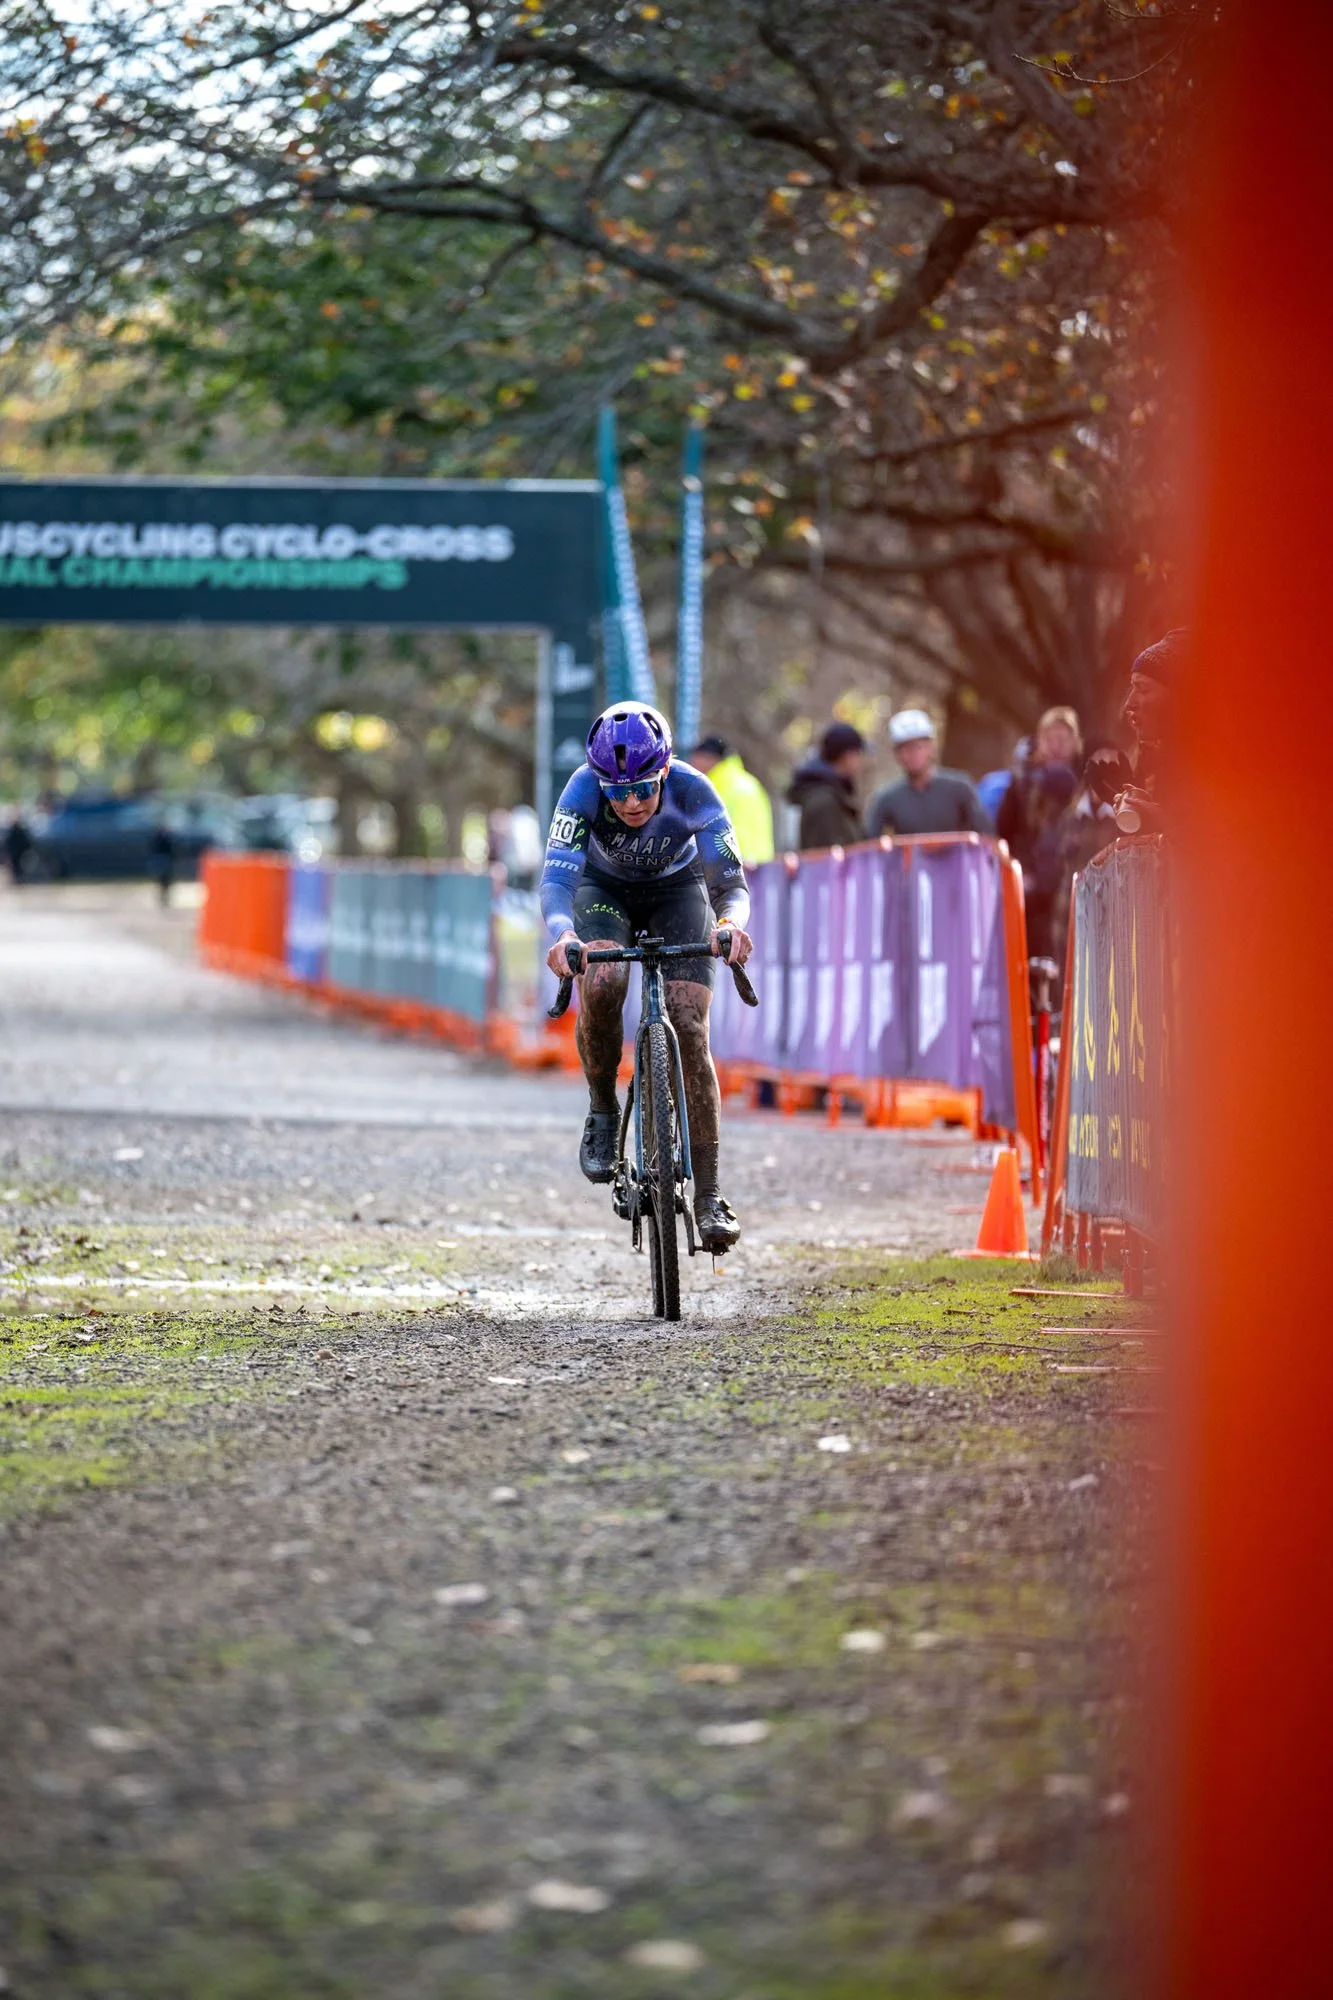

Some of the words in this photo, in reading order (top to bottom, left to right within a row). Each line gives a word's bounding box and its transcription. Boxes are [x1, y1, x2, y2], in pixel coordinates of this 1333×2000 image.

[221, 523, 514, 562] CYCLO-CROSS
[62, 557, 408, 591] CHAMPIONSHIPS
[611, 832, 672, 854] MAAP
